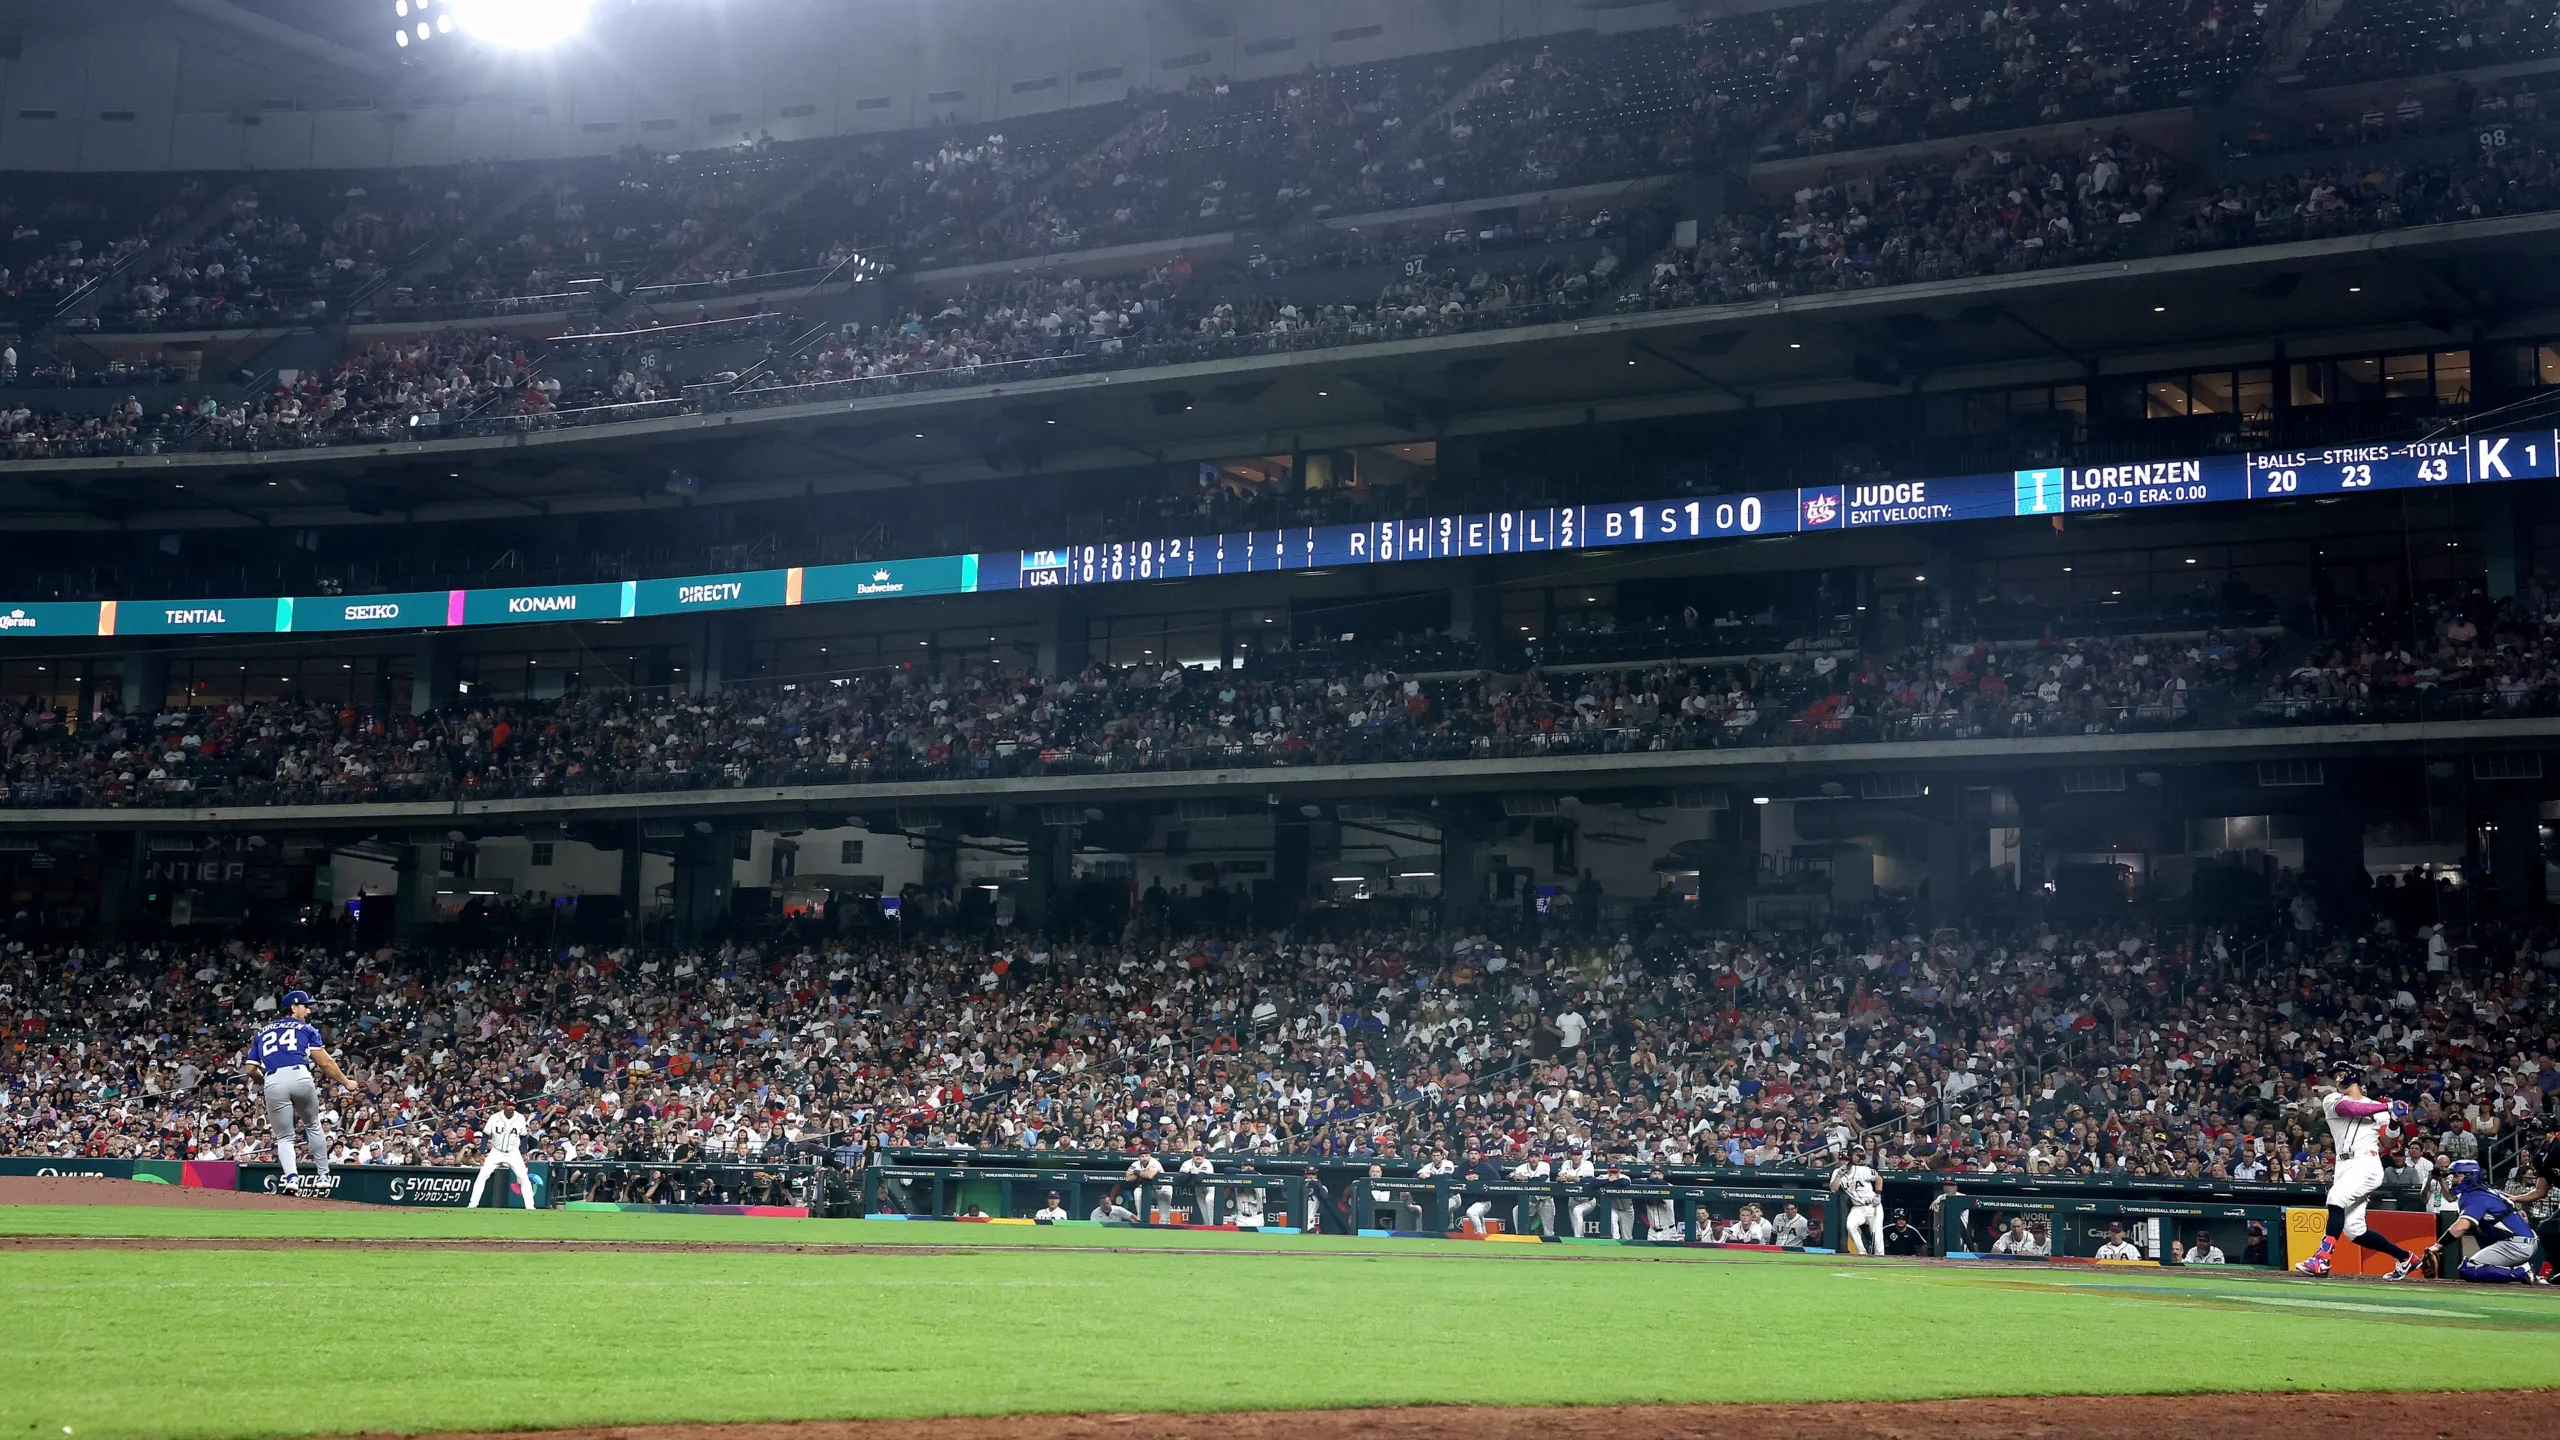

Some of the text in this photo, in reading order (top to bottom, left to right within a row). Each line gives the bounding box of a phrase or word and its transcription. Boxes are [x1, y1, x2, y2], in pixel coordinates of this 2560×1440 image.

[2480, 130, 2506, 149] 98
[1405, 260, 1422, 276] 97
[640, 354, 656, 368] 96
[2258, 441, 2458, 470] BALLS STRIKES TOTAL
[2478, 438, 2537, 480] K 1
[2071, 460, 2200, 491] LORENZEN
[2267, 459, 2448, 493] 20 23 43
[1850, 482, 1925, 508] JUDGE
[2071, 485, 2207, 510] RHP, 0-0 ERA: 0.00
[1500, 512, 1512, 532] 0
[1561, 508, 1573, 527] 2
[1606, 512, 1622, 538] B
[1629, 506, 1644, 540] 1
[1660, 508, 1676, 533] S
[1684, 501, 1700, 536] 1
[1740, 496, 1761, 532] 0
[1850, 504, 1952, 524] EXIT VELOCITY:
[1382, 522, 1392, 542] 5
[1440, 517, 1452, 536] 3
[1469, 523, 1484, 548] E
[1530, 519, 1545, 543] L
[1350, 532, 1366, 556] R
[1408, 528, 1424, 552] H
[1442, 536, 1450, 556] 1
[1501, 532, 1509, 551] 1
[1561, 527, 1574, 547] 2
[1084, 546, 1094, 564] 0
[1112, 543, 1122, 562] 3
[1141, 541, 1152, 560] 0
[1170, 539, 1181, 558] 2
[1381, 541, 1392, 560] 0
[1033, 551, 1057, 567] ITA
[1030, 570, 1058, 587] USA
[1084, 564, 1094, 582] 0
[1112, 562, 1122, 580] 0
[1140, 560, 1151, 578] 0
[679, 582, 742, 604] DIRECTV
[856, 582, 904, 595] Budweiser
[344, 603, 399, 620] SEIKO
[508, 595, 577, 614] KONAMI
[0, 616, 36, 630] Corona
[165, 609, 226, 624] TENTIAL
[144, 862, 244, 881] NTIER
[258, 1021, 304, 1036] LORENZEN
[262, 1028, 298, 1056] 24
[495, 1126, 518, 1136] UA
[278, 1175, 340, 1188] SNCN
[406, 1177, 472, 1192] SYNCRON
[2020, 1212, 2051, 1221] WORL
[1776, 1225, 1797, 1237] UA
